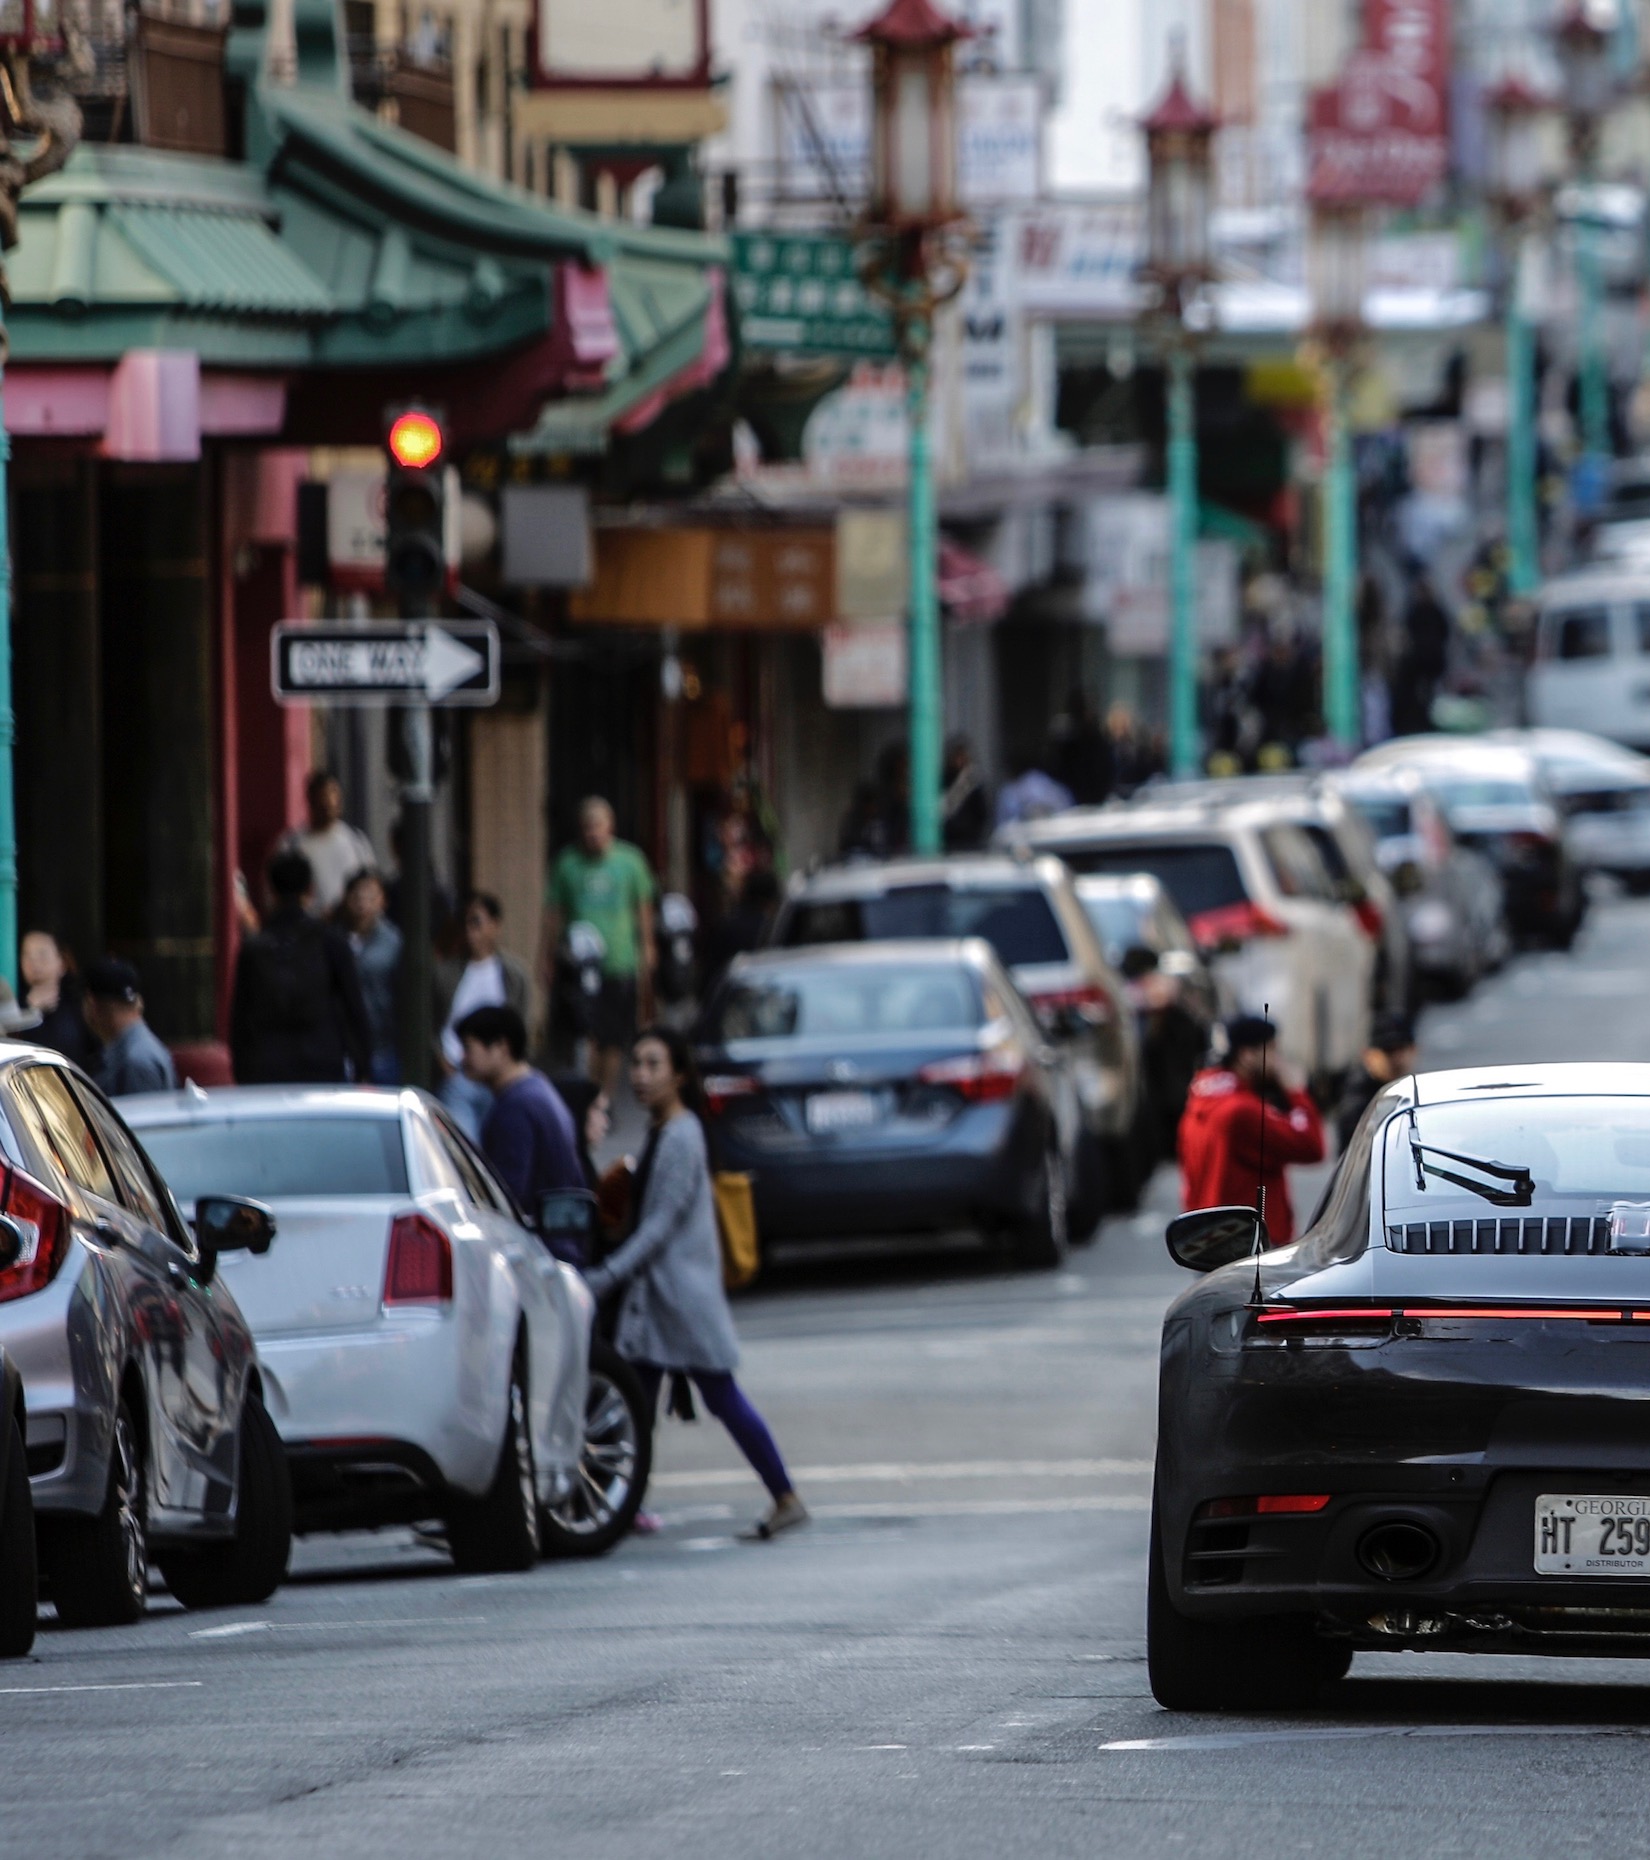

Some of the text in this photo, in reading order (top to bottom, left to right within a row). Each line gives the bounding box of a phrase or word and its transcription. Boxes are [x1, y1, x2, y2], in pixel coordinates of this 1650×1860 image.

[301, 641, 427, 683] ONE WAY
[1541, 1517, 1576, 1555] HT
[1586, 1559, 1644, 1568] DISTRIBUTOR
